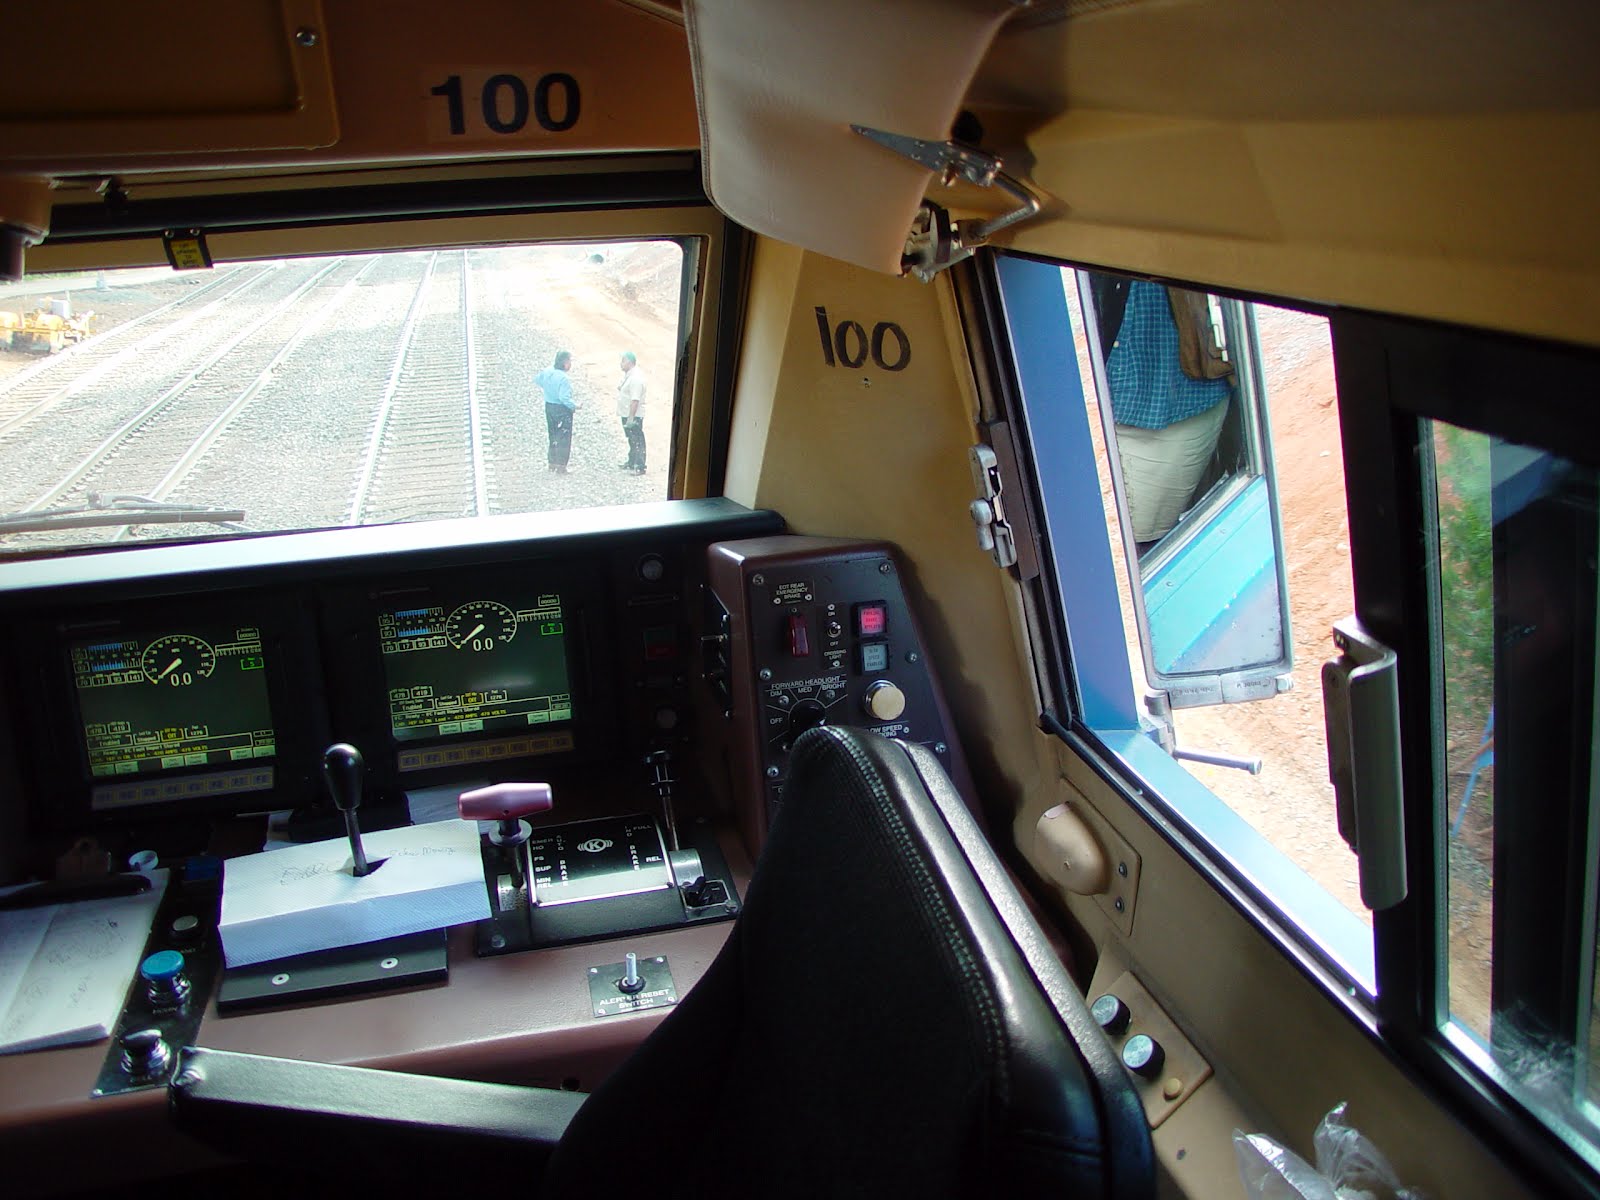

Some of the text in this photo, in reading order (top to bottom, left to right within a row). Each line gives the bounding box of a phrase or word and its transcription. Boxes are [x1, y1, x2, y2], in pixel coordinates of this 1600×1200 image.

[431, 73, 581, 136] 100
[814, 306, 912, 372] 100
[776, 587, 808, 596] EMERGENCY
[472, 637, 494, 651] 0.0
[170, 671, 192, 687] 0.0
[771, 675, 841, 690] FORWARD HEADLIGHT
[797, 686, 812, 694] MED
[821, 683, 846, 691] BRIGHT
[769, 717, 783, 725] OFF
[882, 724, 903, 733] SPEED
[646, 855, 663, 863] REL
[535, 864, 552, 873] SUP
[536, 876, 552, 884] MIN
[640, 988, 670, 999] RESET
[618, 997, 654, 1009] SWITCH
